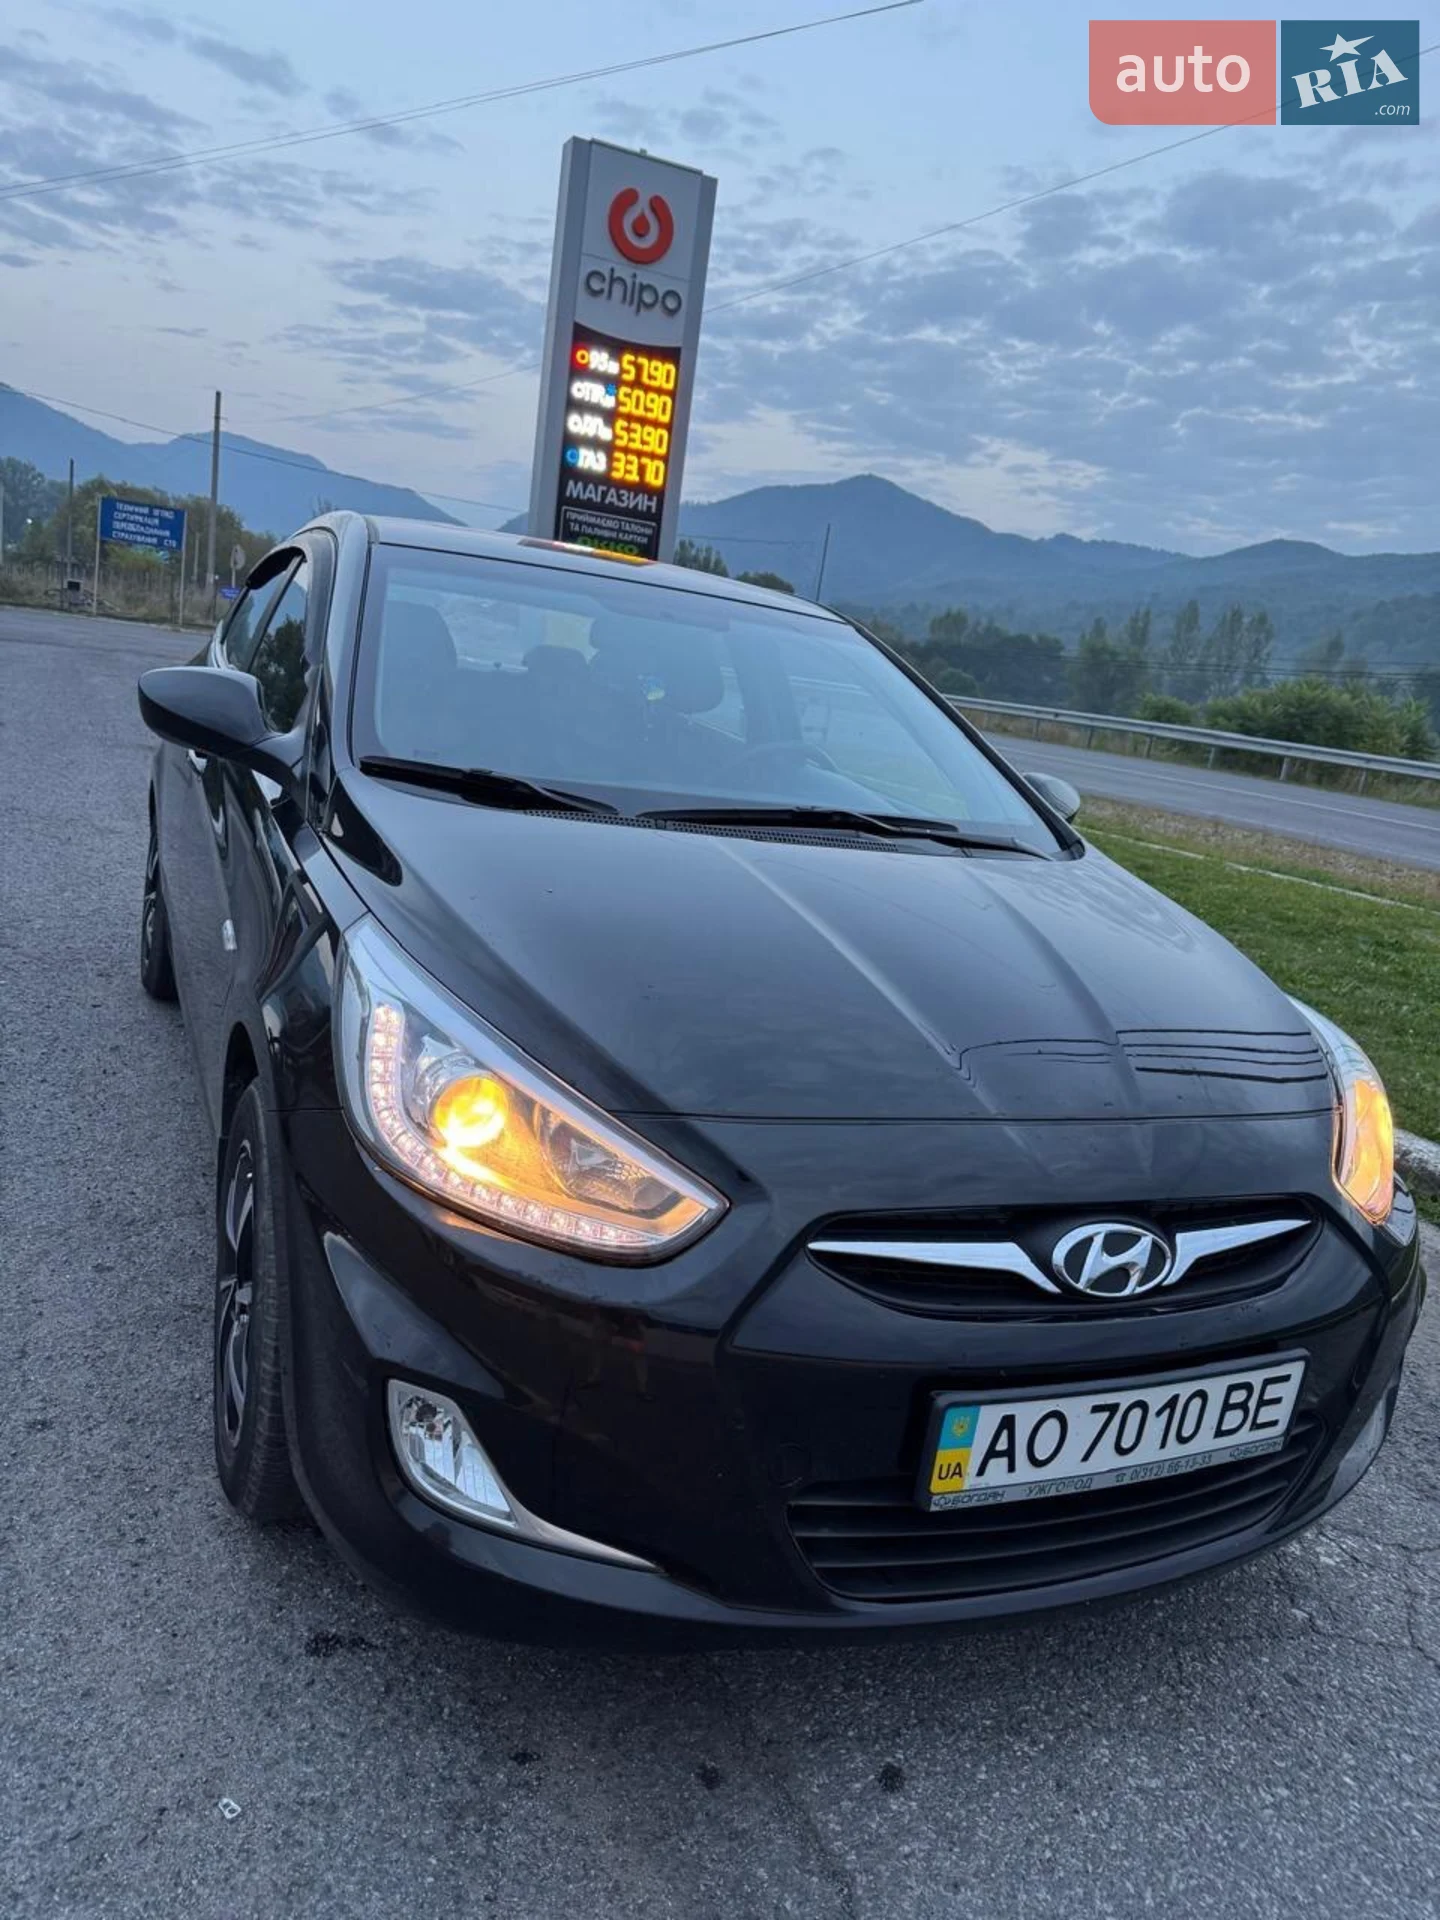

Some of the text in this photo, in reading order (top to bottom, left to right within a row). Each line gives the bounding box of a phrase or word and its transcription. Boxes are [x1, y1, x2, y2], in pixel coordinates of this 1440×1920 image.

[585, 267, 682, 317] chipo
[565, 480, 658, 513] МАГАЗИН
[569, 522, 580, 533] ТА
[618, 532, 649, 544] КАРТКИ
[975, 1373, 1293, 1477] AO 7010 BE
[938, 1463, 964, 1480] UA
